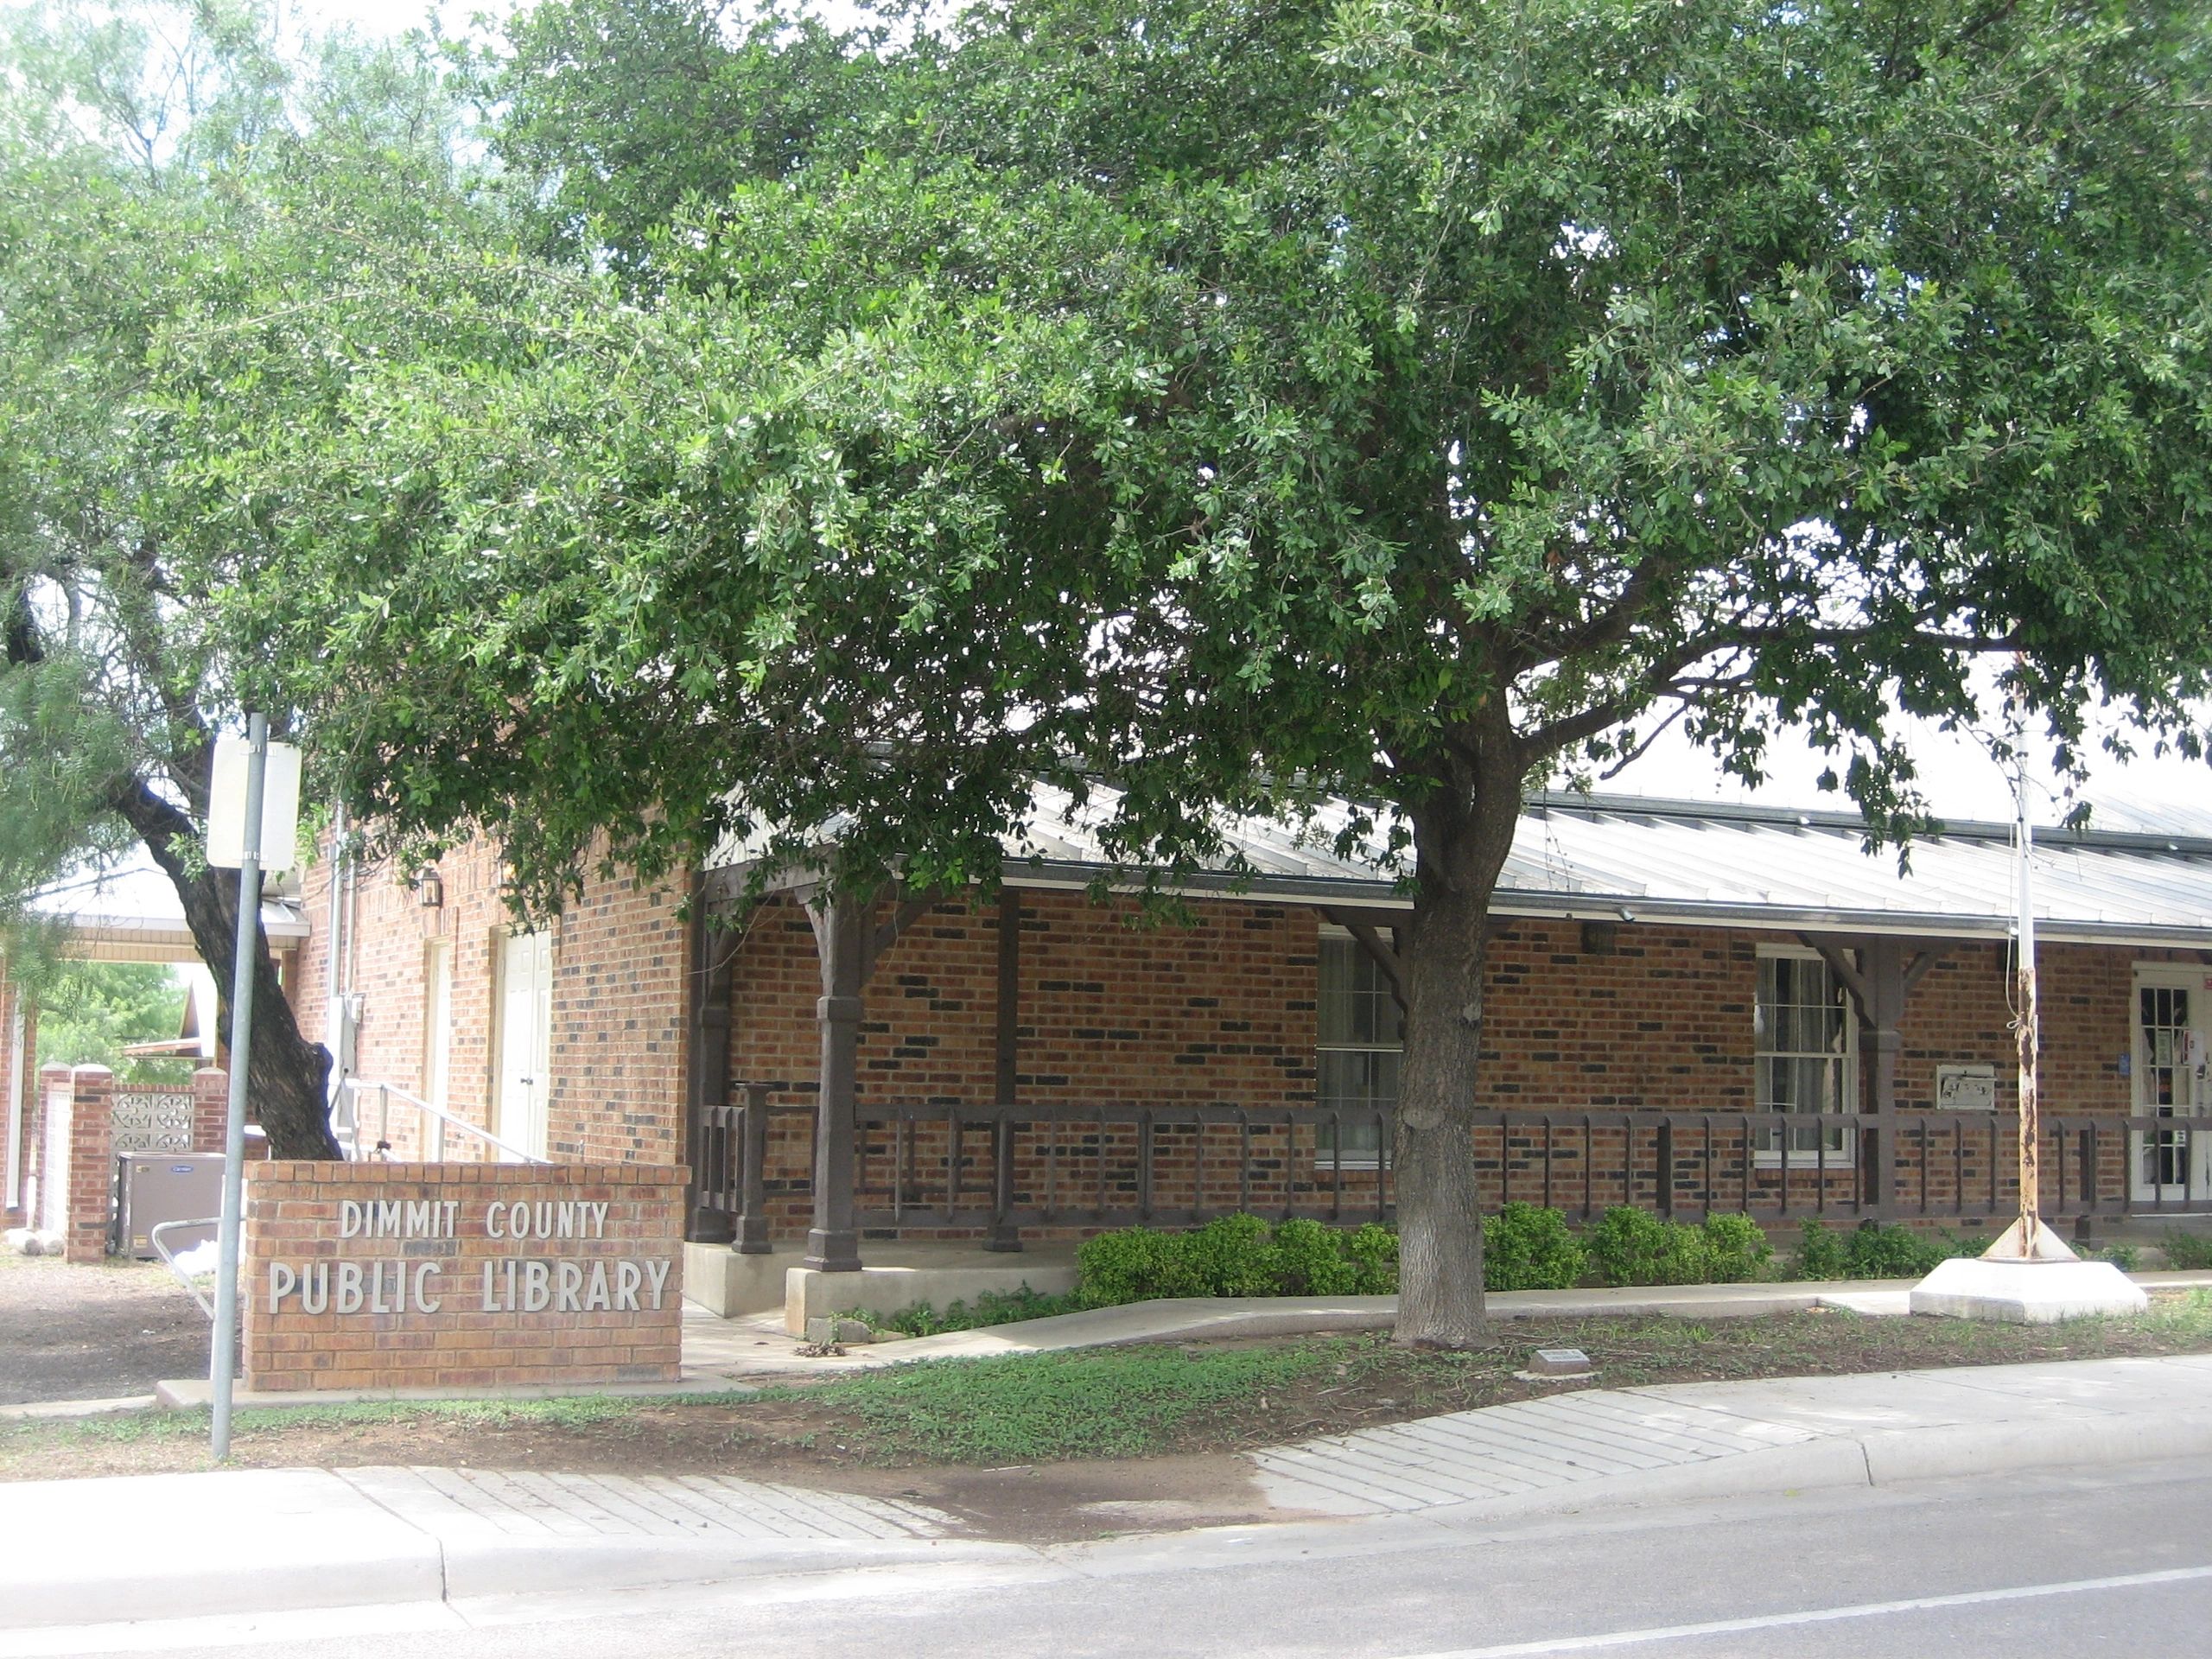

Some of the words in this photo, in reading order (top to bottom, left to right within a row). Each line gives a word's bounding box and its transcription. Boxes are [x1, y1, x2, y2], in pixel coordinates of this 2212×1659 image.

[340, 1199, 459, 1238] DIMMIT
[486, 1201, 609, 1239] COUNTY
[269, 1261, 442, 1314] PUBLIC
[483, 1260, 671, 1312] LIBRARY
